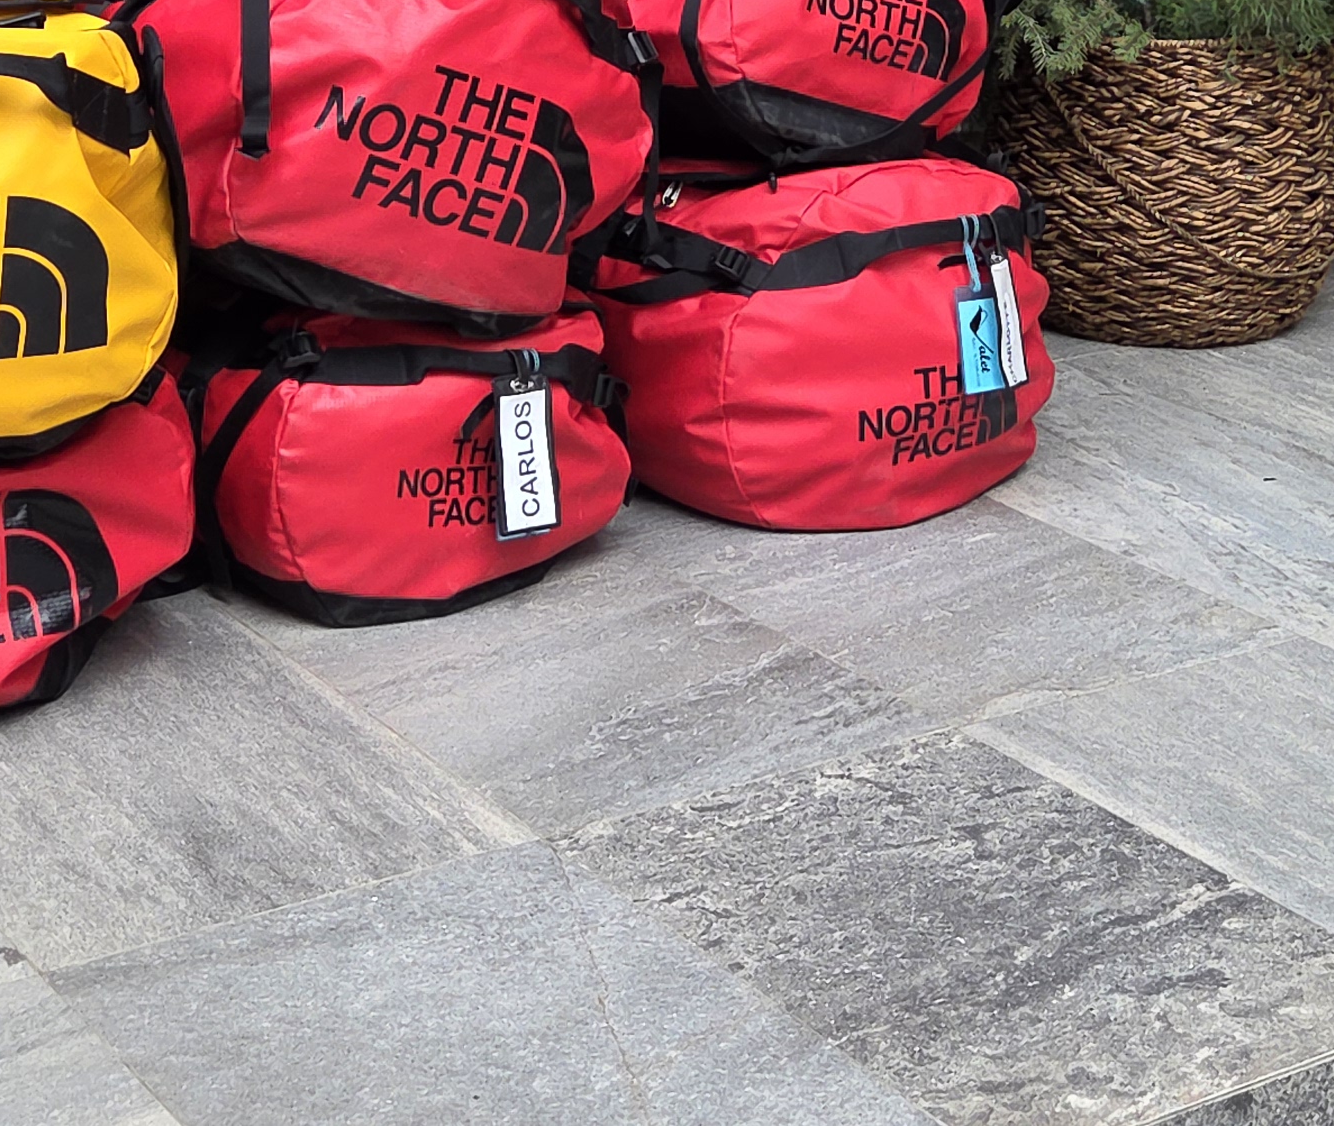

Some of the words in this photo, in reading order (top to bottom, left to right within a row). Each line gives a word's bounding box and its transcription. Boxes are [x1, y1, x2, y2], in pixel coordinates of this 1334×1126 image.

[833, 22, 915, 69] FACE
[435, 64, 537, 141] THE
[314, 84, 522, 190] NORTH
[351, 154, 506, 239] FACE
[913, 362, 962, 400] TH
[858, 394, 981, 442] NORTH
[453, 437, 496, 465] TH
[513, 400, 540, 517] CARLOS
[892, 421, 977, 466] FACE
